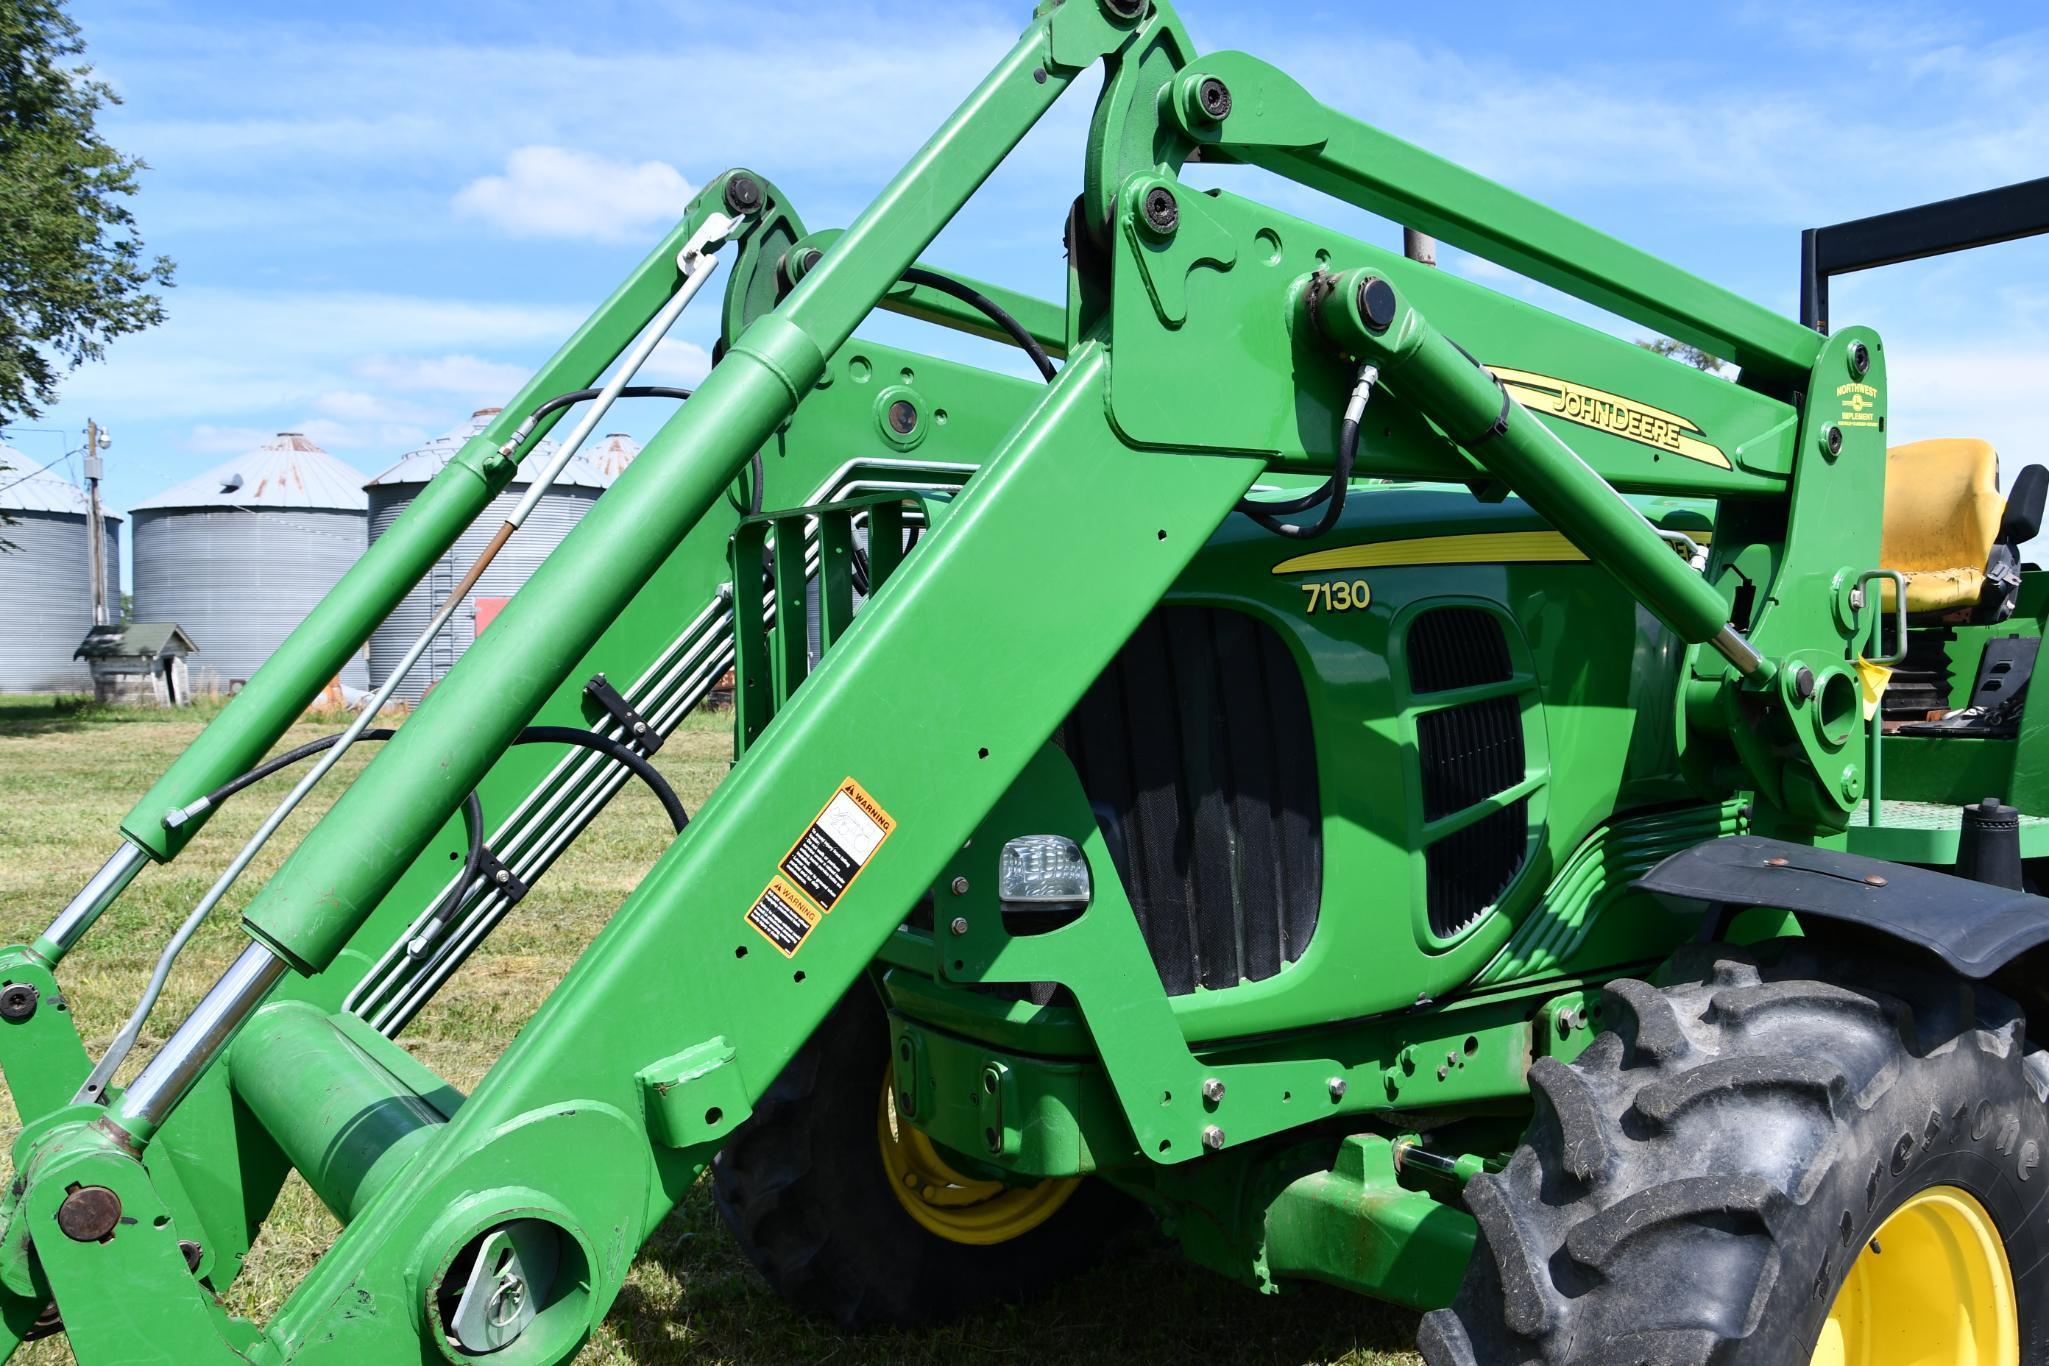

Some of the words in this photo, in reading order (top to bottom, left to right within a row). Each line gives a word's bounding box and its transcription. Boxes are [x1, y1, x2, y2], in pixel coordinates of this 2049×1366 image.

[1836, 383, 1877, 398] NORTHWEST
[1552, 384, 1611, 428] JOHN
[1610, 400, 1681, 449] DEERE
[1301, 580, 1371, 613] 7130
[854, 793, 891, 830] WARNING
[781, 887, 816, 921] WARNING
